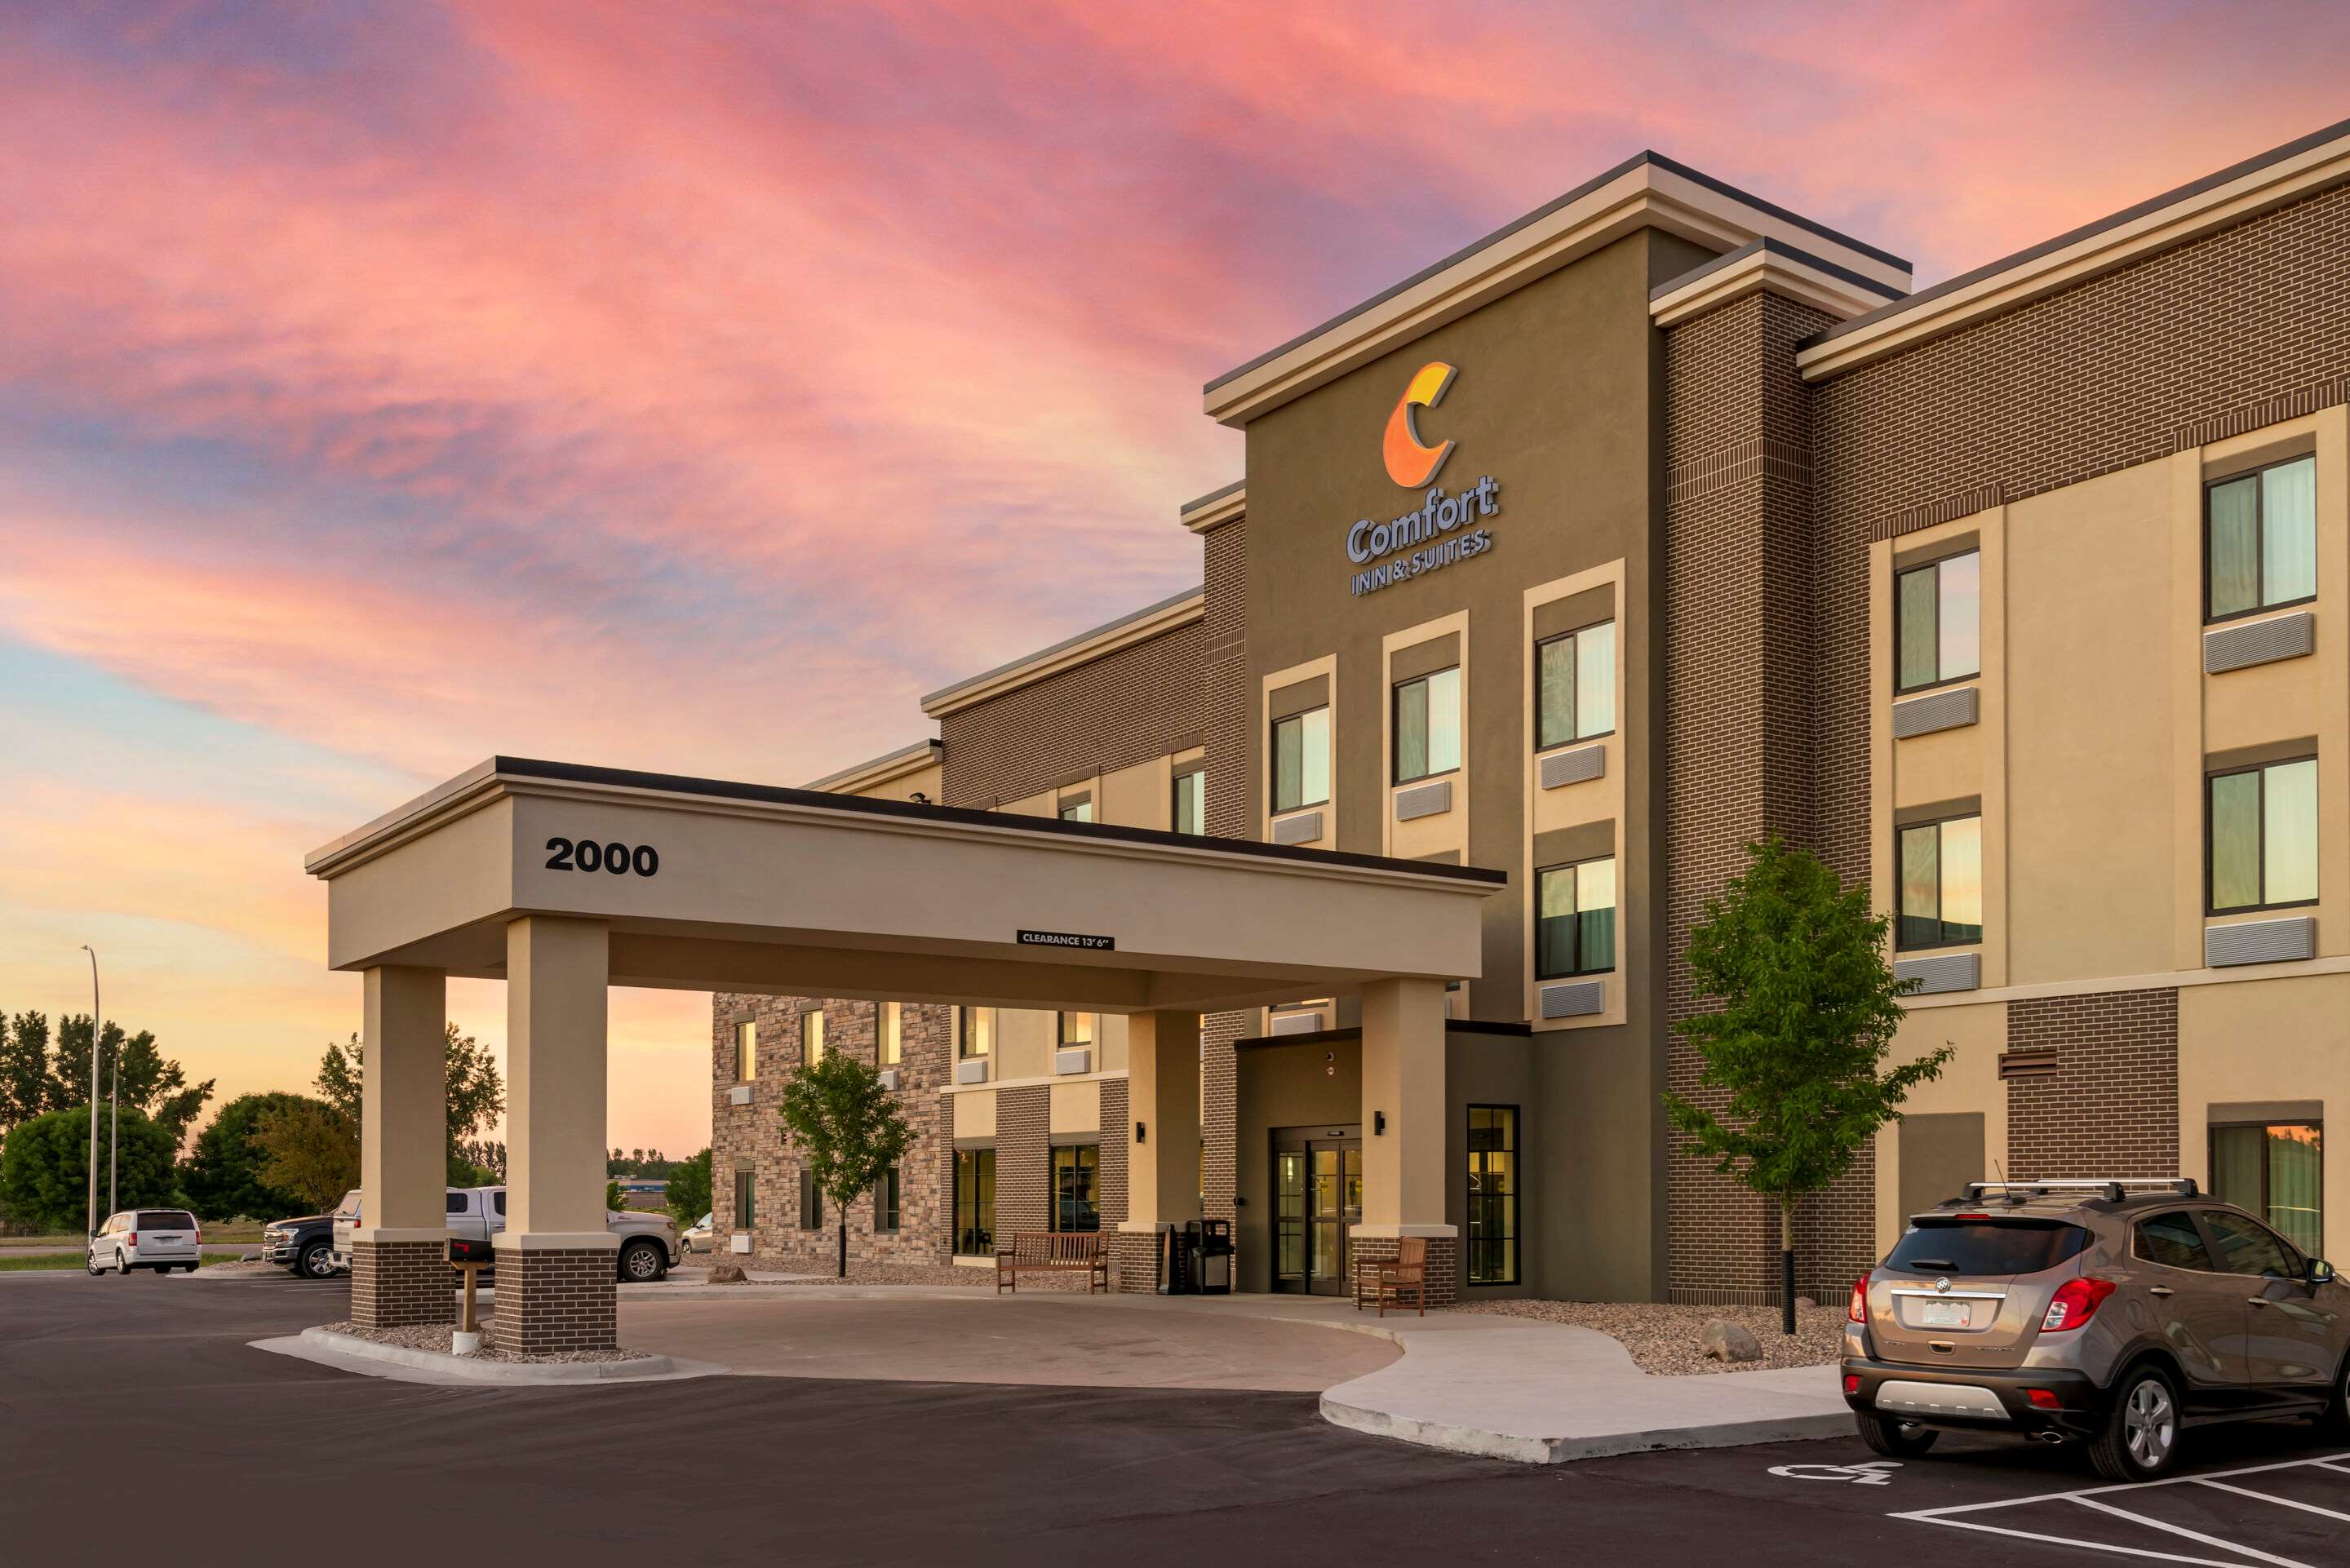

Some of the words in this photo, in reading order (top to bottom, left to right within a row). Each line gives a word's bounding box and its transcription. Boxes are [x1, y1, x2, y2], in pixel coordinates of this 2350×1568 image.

[1346, 475, 1500, 565] Comfort
[1351, 565, 1391, 597] INN
[1392, 560, 1412, 581] &
[1412, 529, 1492, 574] SUITES
[545, 837, 659, 877] 2000
[1022, 933, 1080, 946] CLEARANCE
